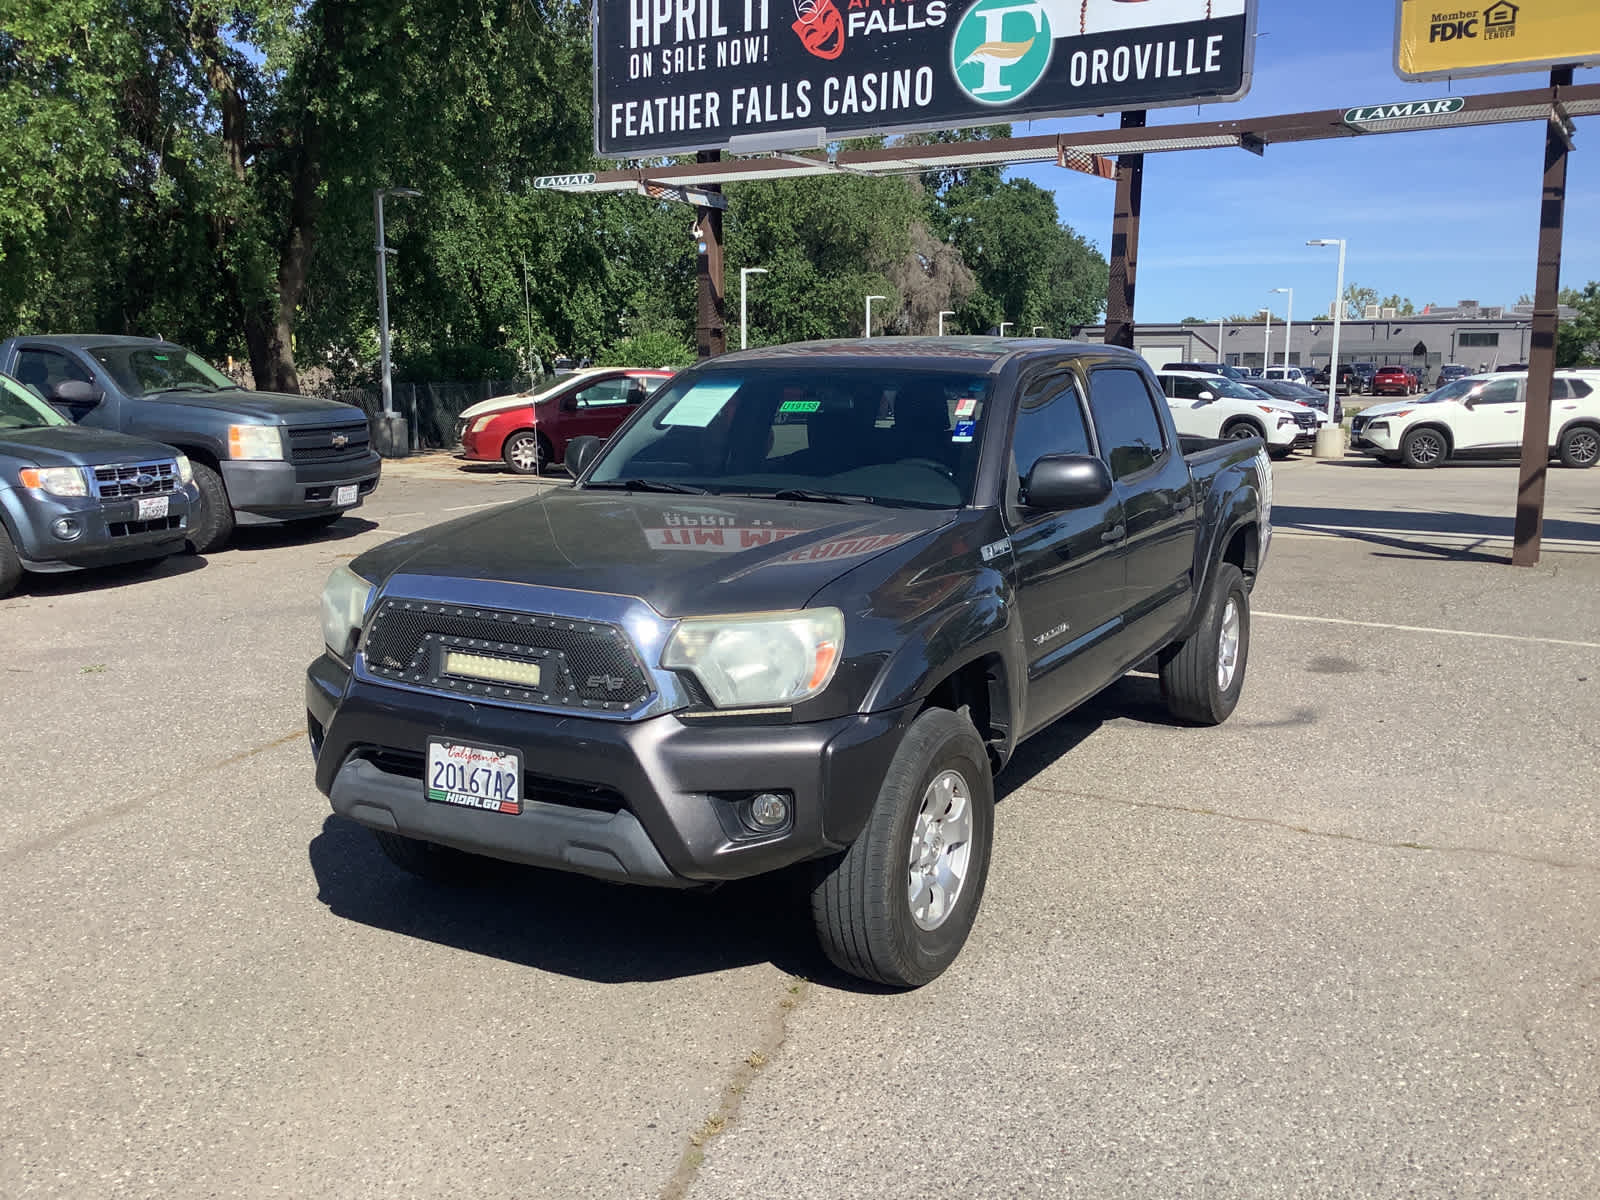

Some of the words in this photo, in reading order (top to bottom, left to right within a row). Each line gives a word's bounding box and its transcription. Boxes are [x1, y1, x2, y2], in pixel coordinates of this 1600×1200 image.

[629, 0, 728, 48] APRIL
[848, 1, 947, 37] FALLS
[1429, 19, 1479, 43] FDIC
[1431, 11, 1479, 22] Member
[630, 52, 652, 79] ON
[662, 44, 706, 75] SALE
[717, 35, 768, 68] NOW!
[1070, 34, 1223, 87] OROVILLE
[611, 91, 720, 138] FEATHER
[732, 80, 811, 125] FALLS
[823, 66, 933, 115] CASINO
[1354, 100, 1452, 121] LAMAR
[540, 175, 590, 187] LAMAR
[433, 761, 516, 801] 20167A2
[446, 792, 501, 811] HIDALGO
